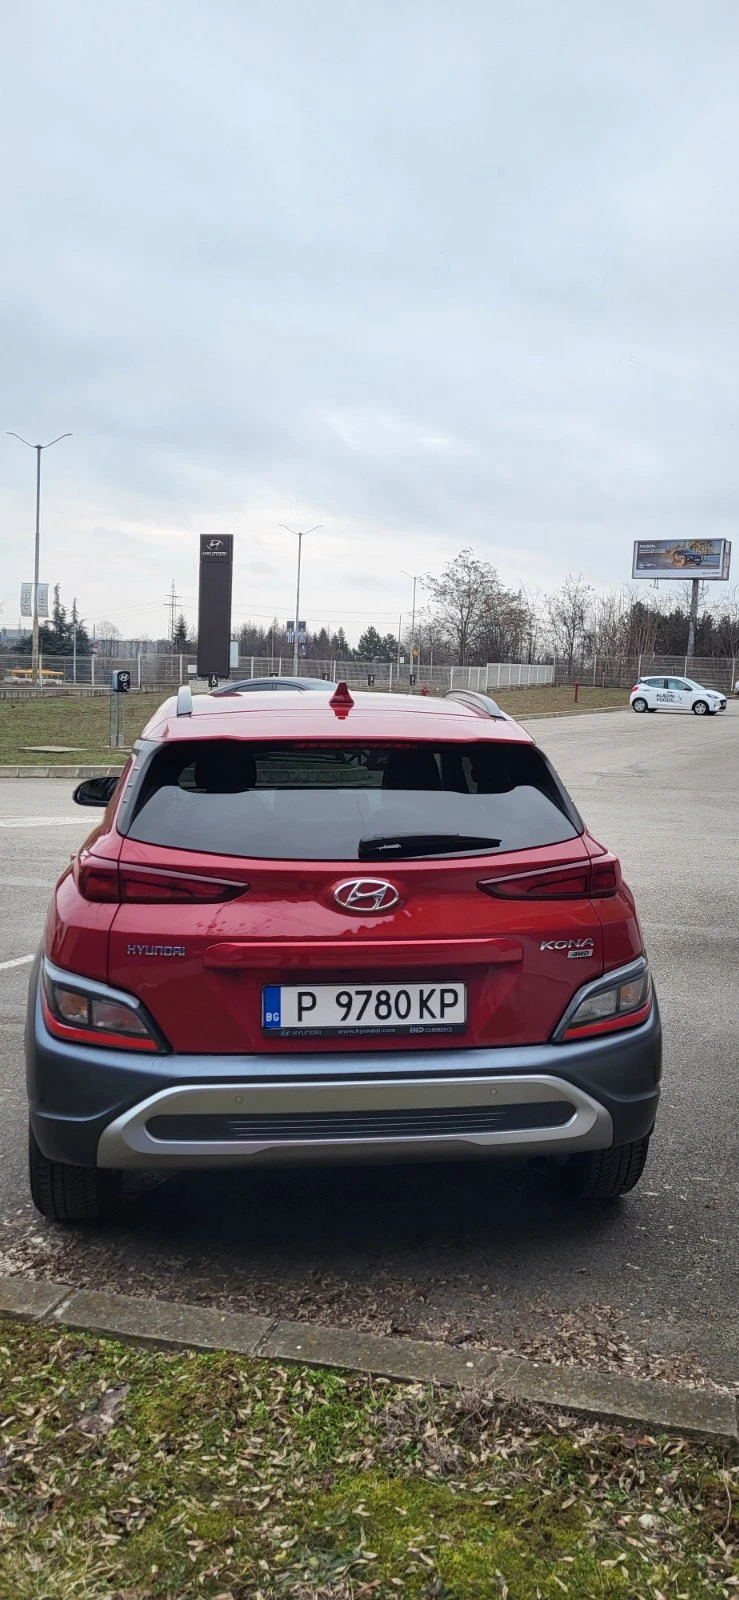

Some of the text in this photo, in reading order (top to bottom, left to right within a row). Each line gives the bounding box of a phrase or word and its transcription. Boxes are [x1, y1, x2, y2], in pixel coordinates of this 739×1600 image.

[127, 944, 186, 957] HYUNDAI
[540, 937, 594, 951] KONA
[297, 991, 317, 1022] P
[266, 1012, 279, 1022] BG
[337, 1027, 396, 1035] www.hyundai.com
